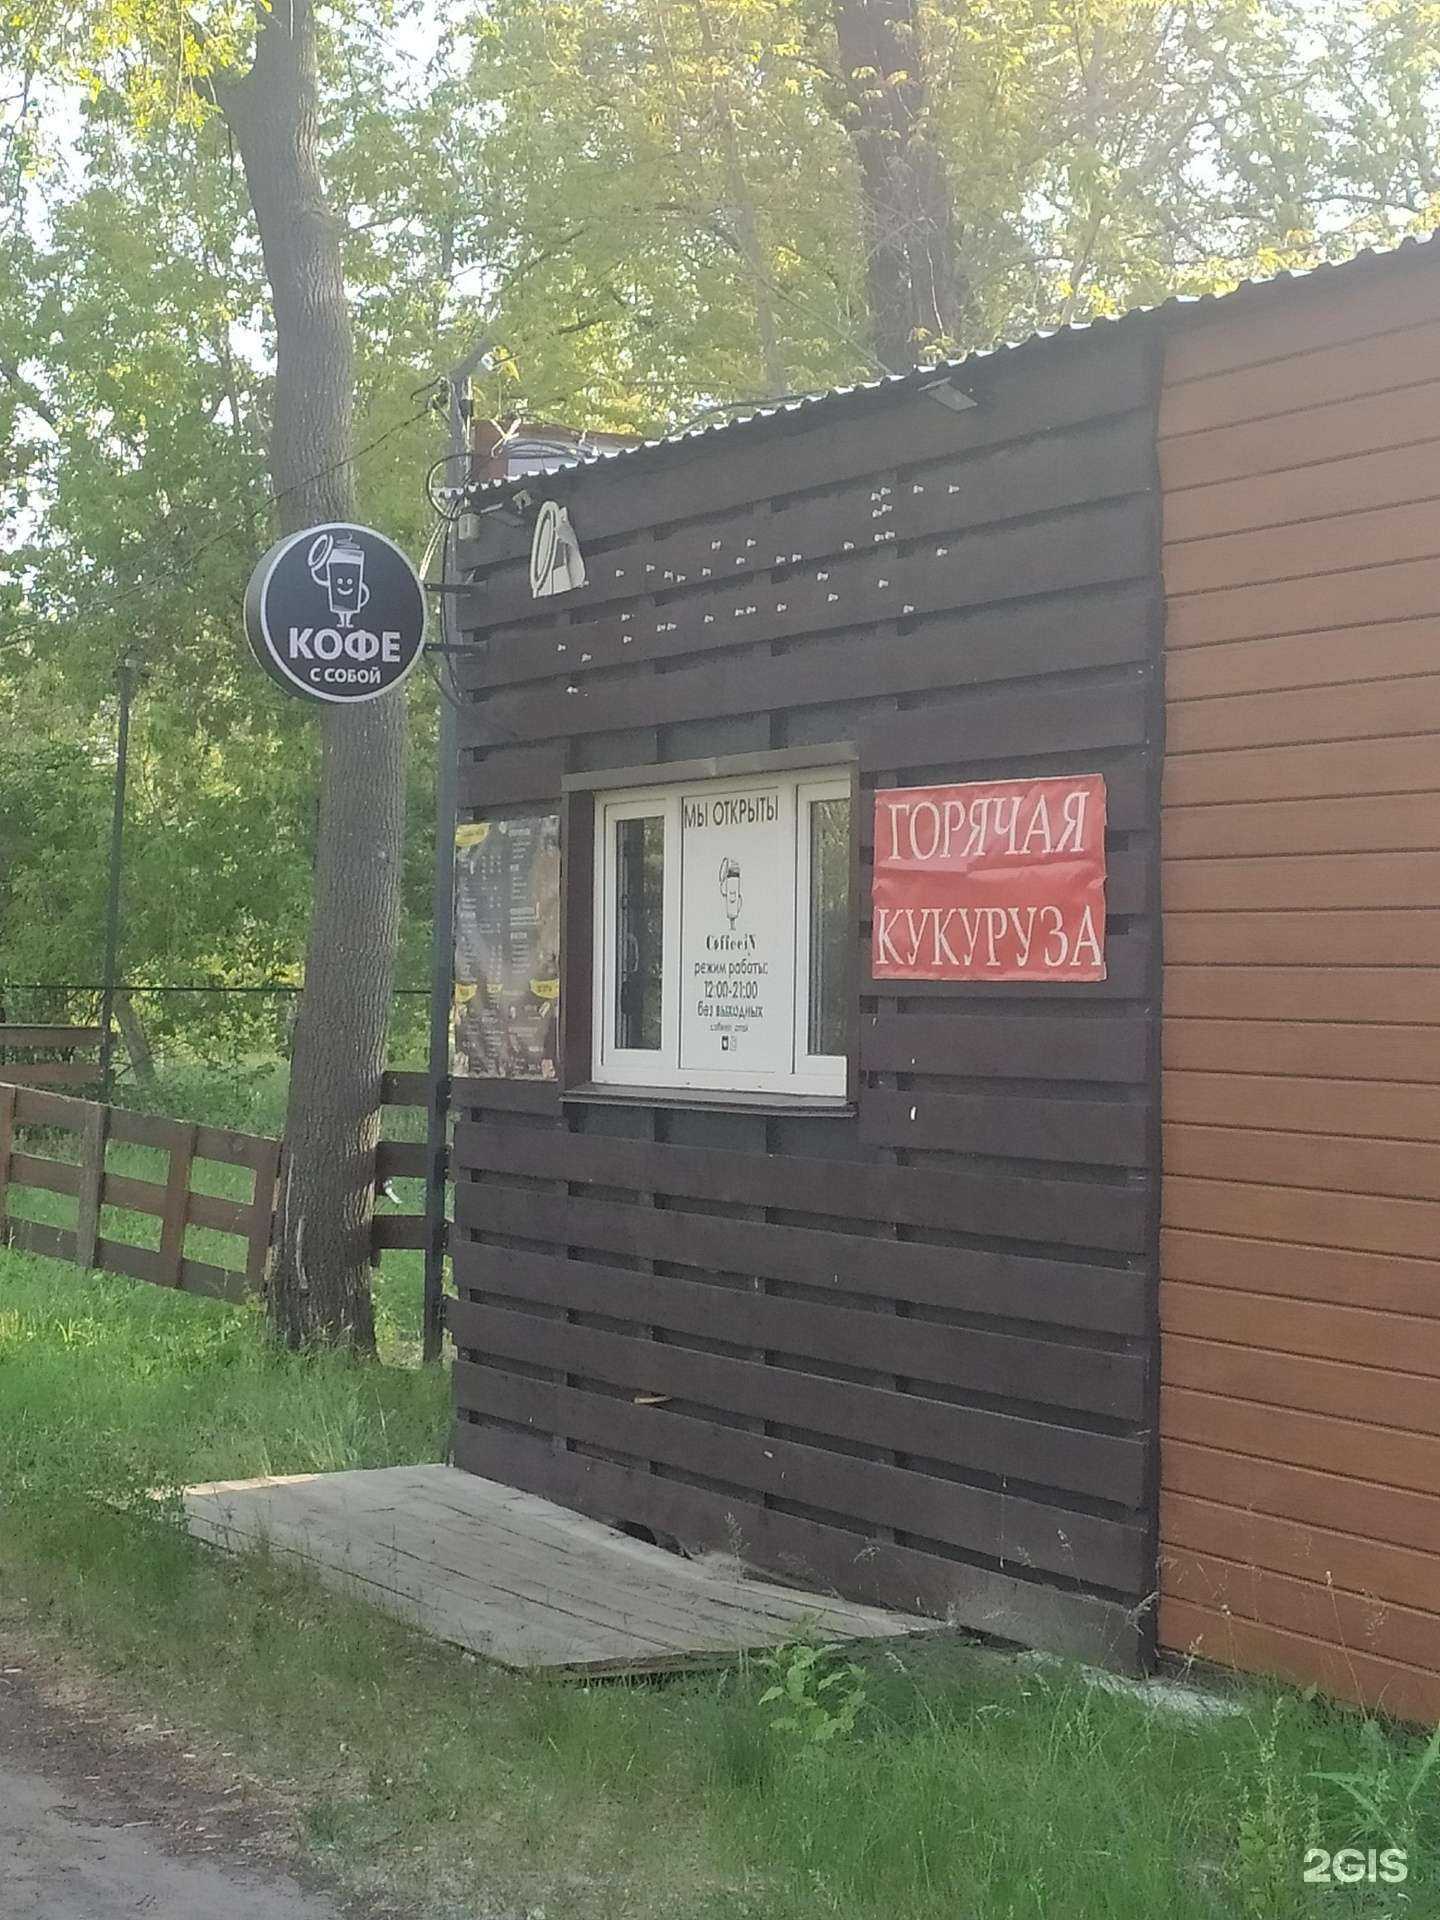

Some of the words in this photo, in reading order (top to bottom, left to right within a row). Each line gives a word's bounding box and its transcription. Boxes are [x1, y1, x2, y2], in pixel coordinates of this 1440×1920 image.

[289, 627, 401, 662] КОФЕ
[310, 668, 322, 682] С
[324, 666, 382, 684] СОБОЙ
[684, 801, 708, 828] МЫ
[713, 795, 779, 826] ОТКРЫТЫ
[888, 791, 1090, 861] ГОРЯЧАЯ
[875, 905, 1102, 967] КУКУРУЗА
[695, 962, 726, 977] режим
[697, 1000, 714, 1017] без
